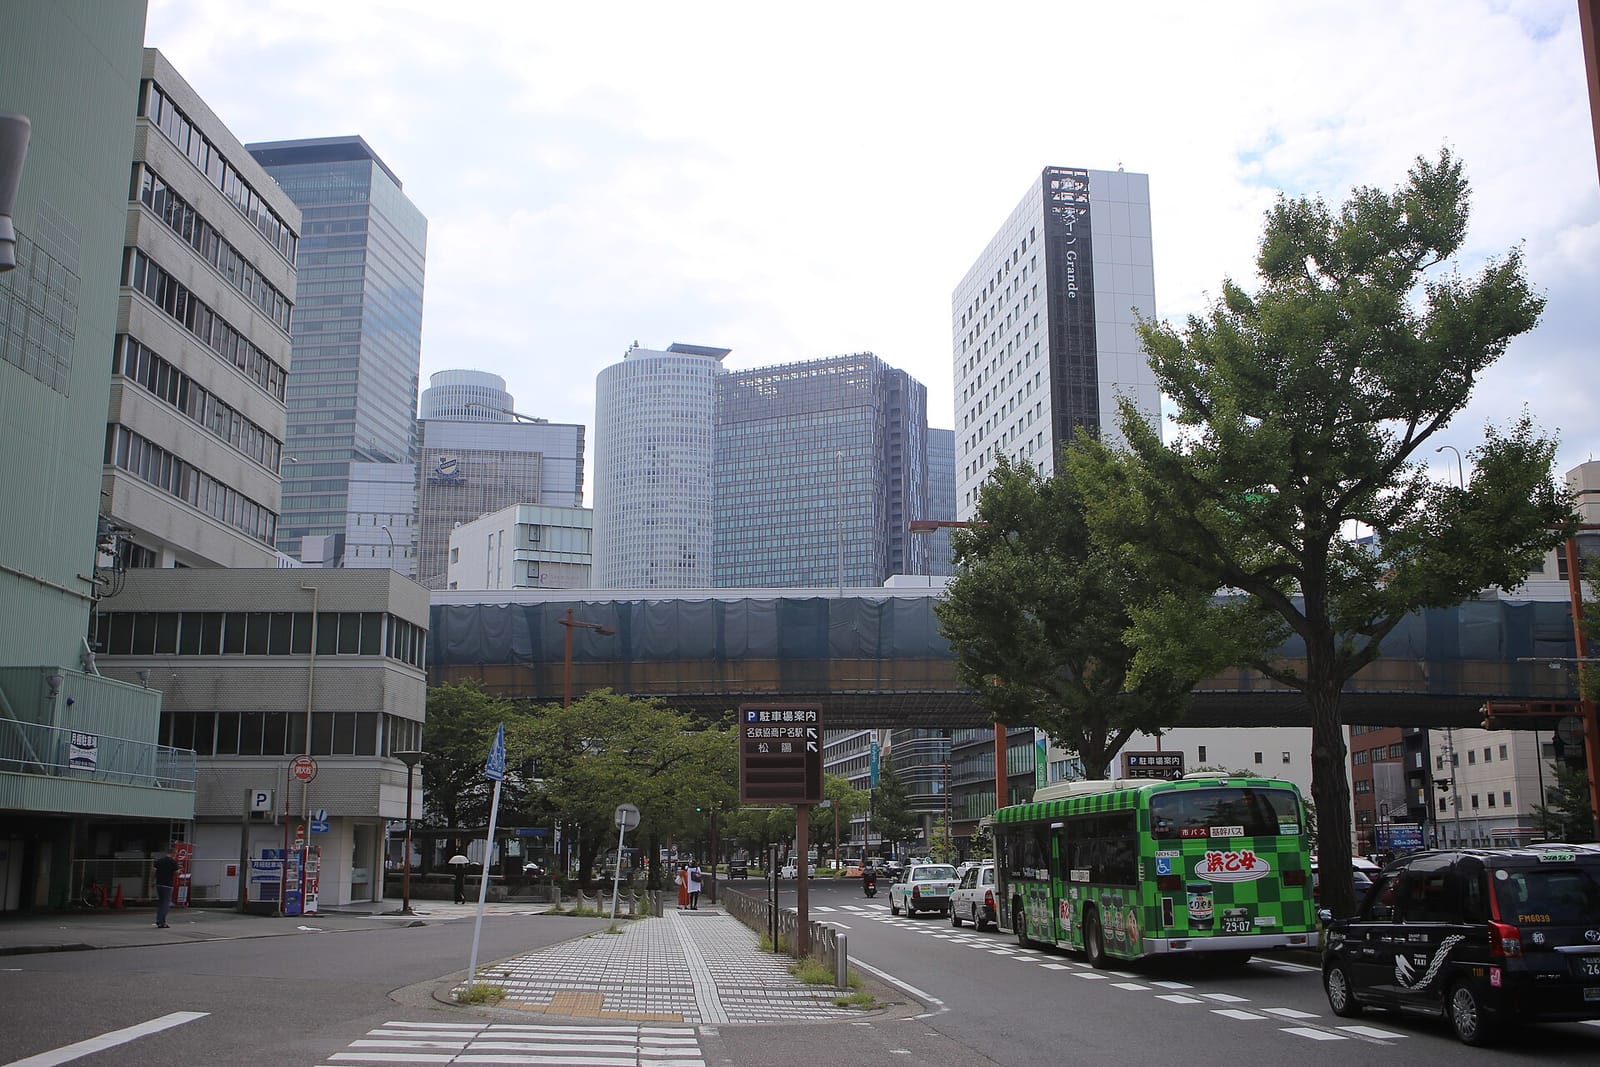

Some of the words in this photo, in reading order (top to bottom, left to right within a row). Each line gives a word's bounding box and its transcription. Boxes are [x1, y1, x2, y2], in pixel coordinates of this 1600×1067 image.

[1066, 250, 1079, 298] Grande
[748, 711, 756, 721] P
[759, 710, 816, 722] 駐車場案内
[746, 727, 804, 738] 名鉄協商P名駅
[1130, 756, 1137, 765] P
[1138, 756, 1180, 766] 駐車場案内
[1130, 769, 1171, 778] ユニモール
[256, 793, 267, 807] P
[1182, 828, 1207, 836] 市バス
[1206, 852, 1256, 872] 浜乙女
[1188, 900, 1212, 910] てりやき
[1518, 913, 1551, 923] FM6039
